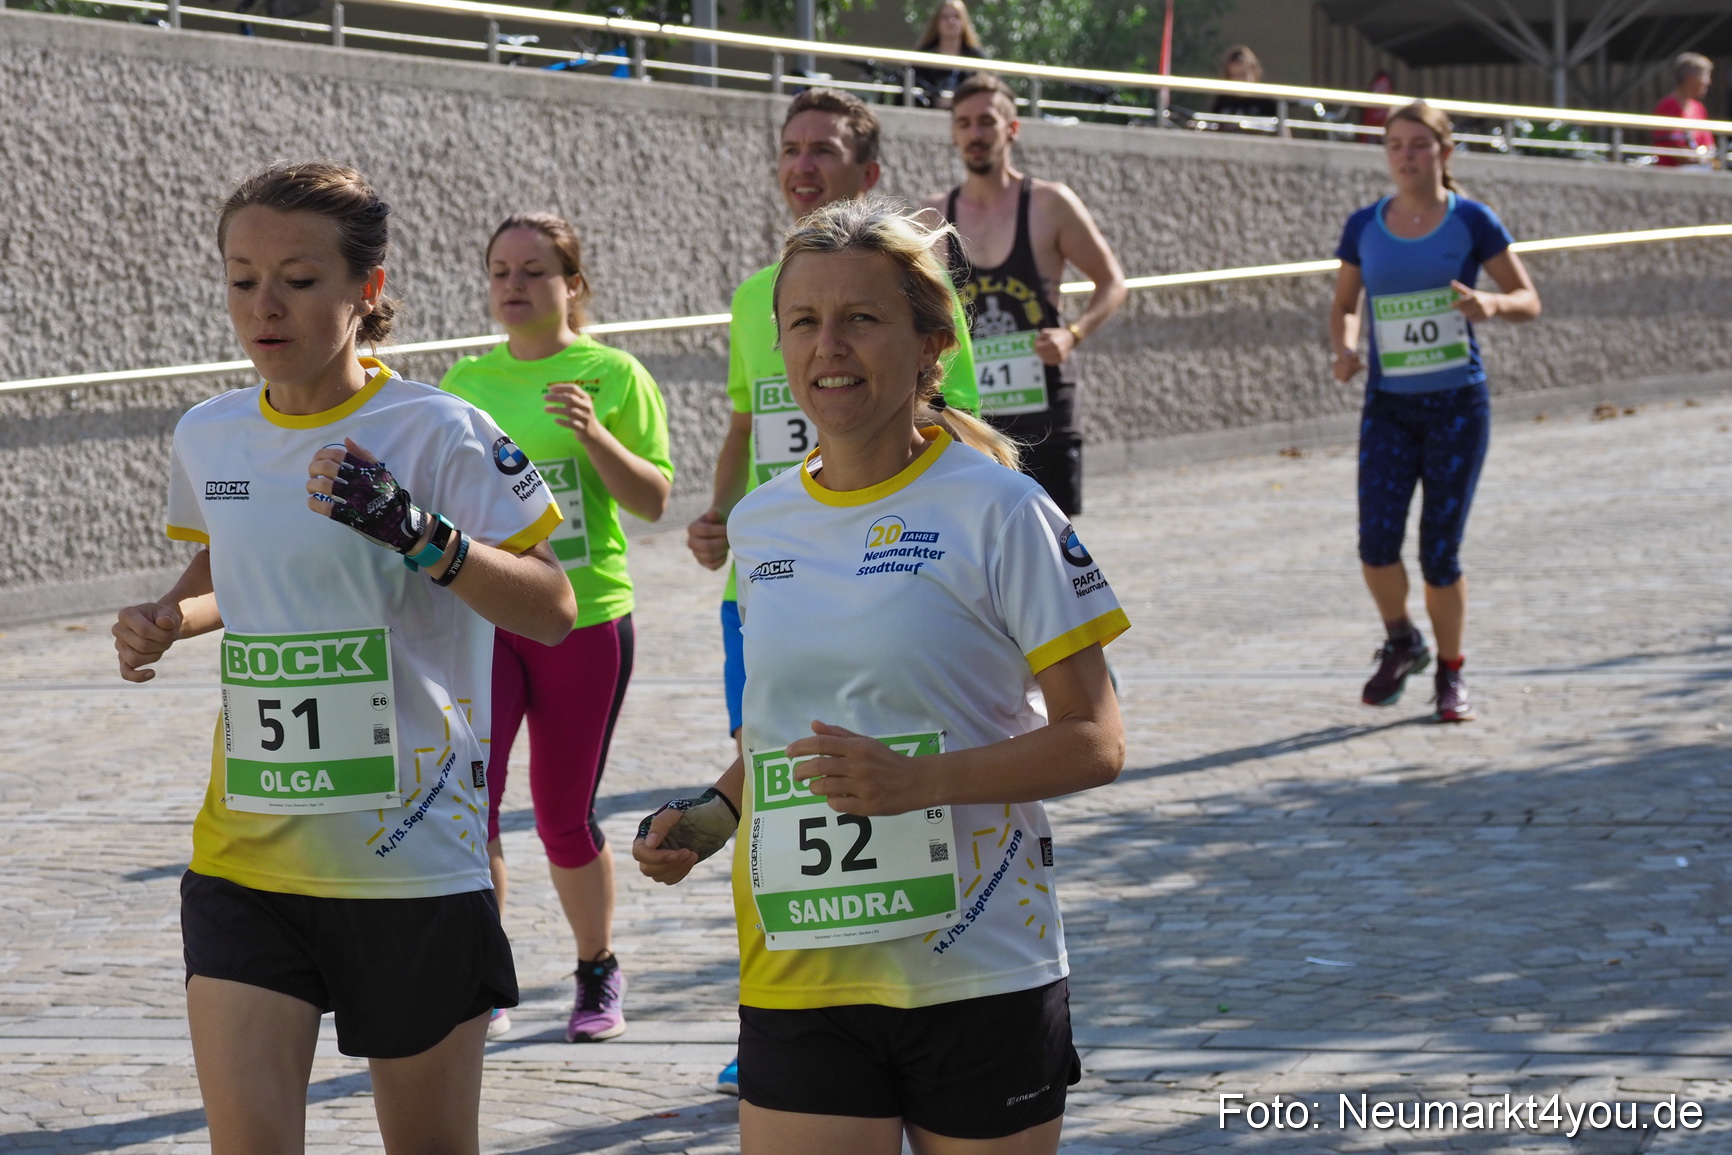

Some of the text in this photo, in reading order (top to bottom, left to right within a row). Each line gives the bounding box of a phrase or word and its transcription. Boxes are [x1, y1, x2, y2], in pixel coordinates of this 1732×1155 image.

[1380, 291, 1454, 317] BOCK
[1405, 320, 1438, 344] 40
[974, 334, 1037, 359] OCK
[979, 363, 1012, 387] 41
[761, 382, 800, 411] BO
[787, 418, 819, 453] 3
[205, 480, 250, 496] BOCK
[511, 469, 540, 496] PART
[868, 523, 937, 549] 20 JAHRE
[862, 545, 946, 563] Neumarkter
[856, 561, 924, 576] Stadtlauf
[1072, 568, 1102, 590] PART
[226, 636, 374, 681] BOCK
[372, 697, 387, 707] E6
[258, 698, 320, 751] 51
[260, 769, 335, 793] OLGA
[375, 752, 457, 858] 14./15. September 2019
[926, 808, 943, 819] E6
[799, 814, 877, 876] 52
[933, 829, 1023, 955] 14./15. September 2019
[788, 889, 914, 925] SANDRA
